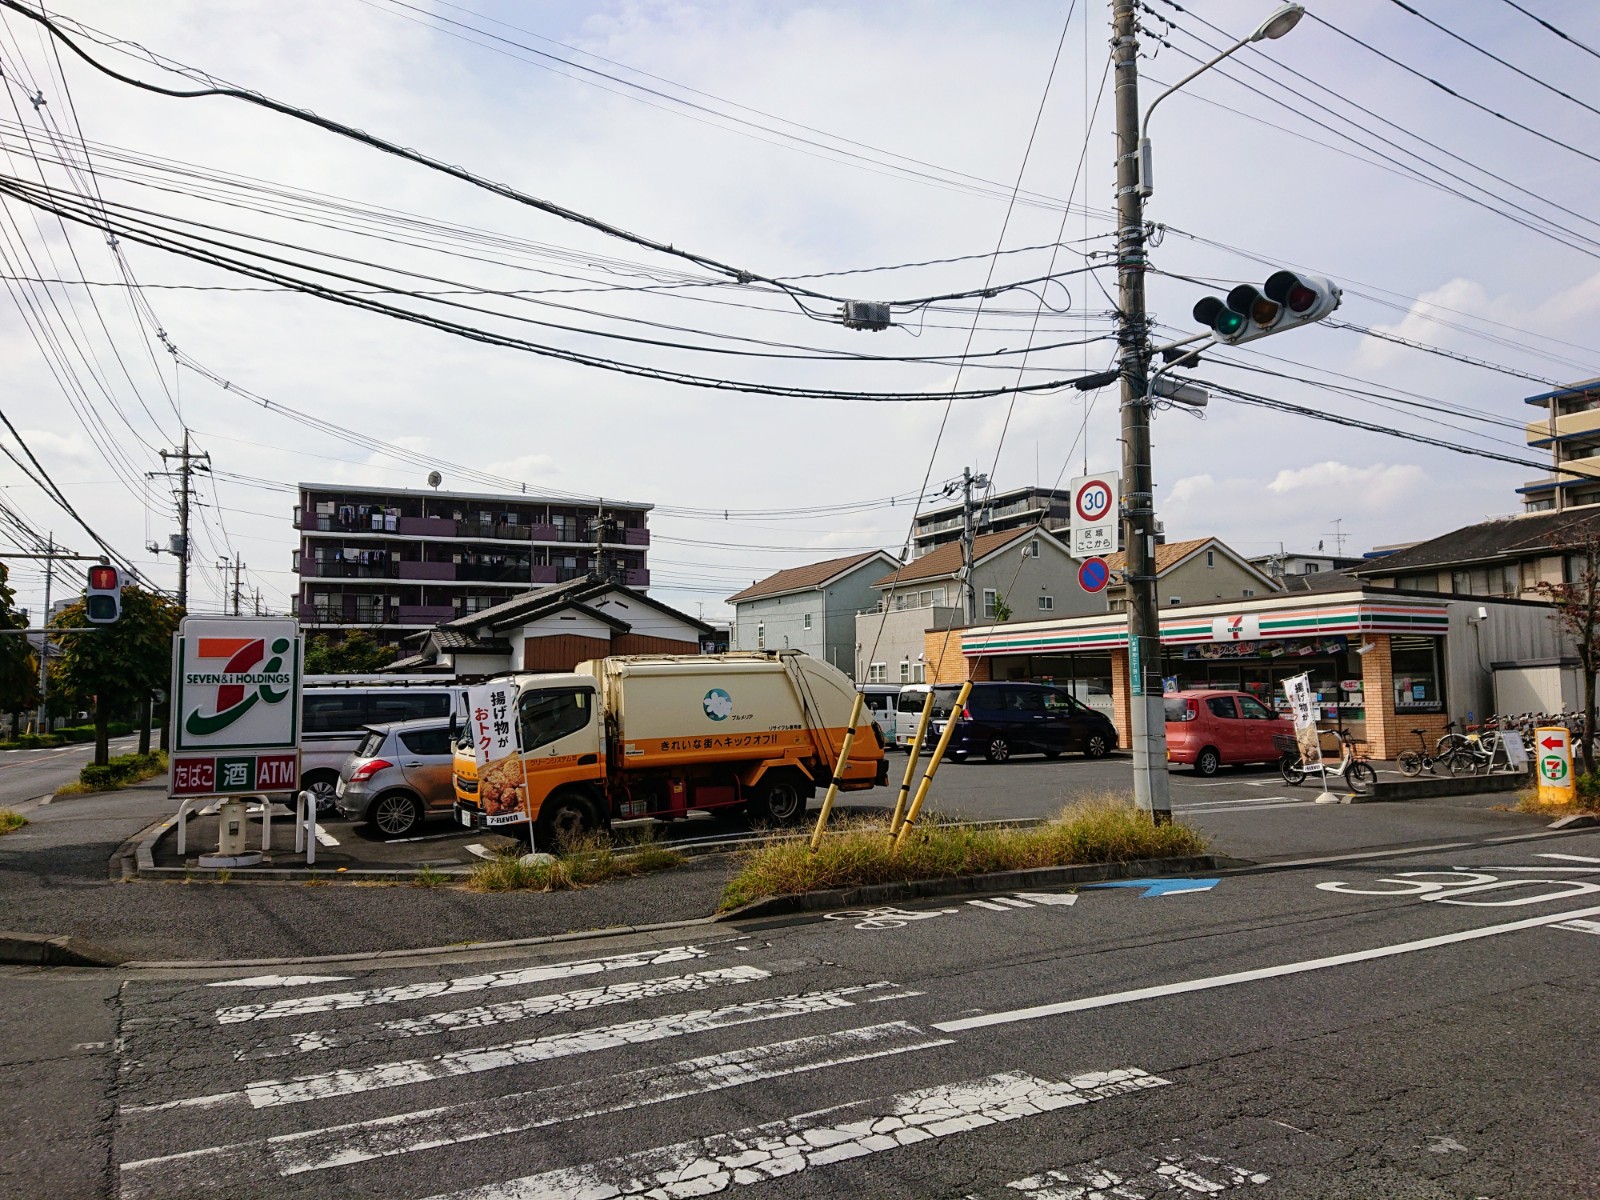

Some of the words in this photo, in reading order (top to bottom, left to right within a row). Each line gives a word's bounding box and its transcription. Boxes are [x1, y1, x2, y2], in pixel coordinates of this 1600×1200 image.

[1084, 491, 1105, 511] 30
[1078, 538, 1111, 550] ここから
[236, 673, 290, 684] HOLDINGS
[490, 690, 510, 749] 揚げ物が
[475, 707, 492, 763] おトク!
[660, 734, 778, 751] きれいな街へキックオフ!!
[175, 764, 213, 788] たばこ
[223, 763, 249, 787] 酒
[258, 761, 294, 784] ATM
[1315, 871, 1600, 907] 30
